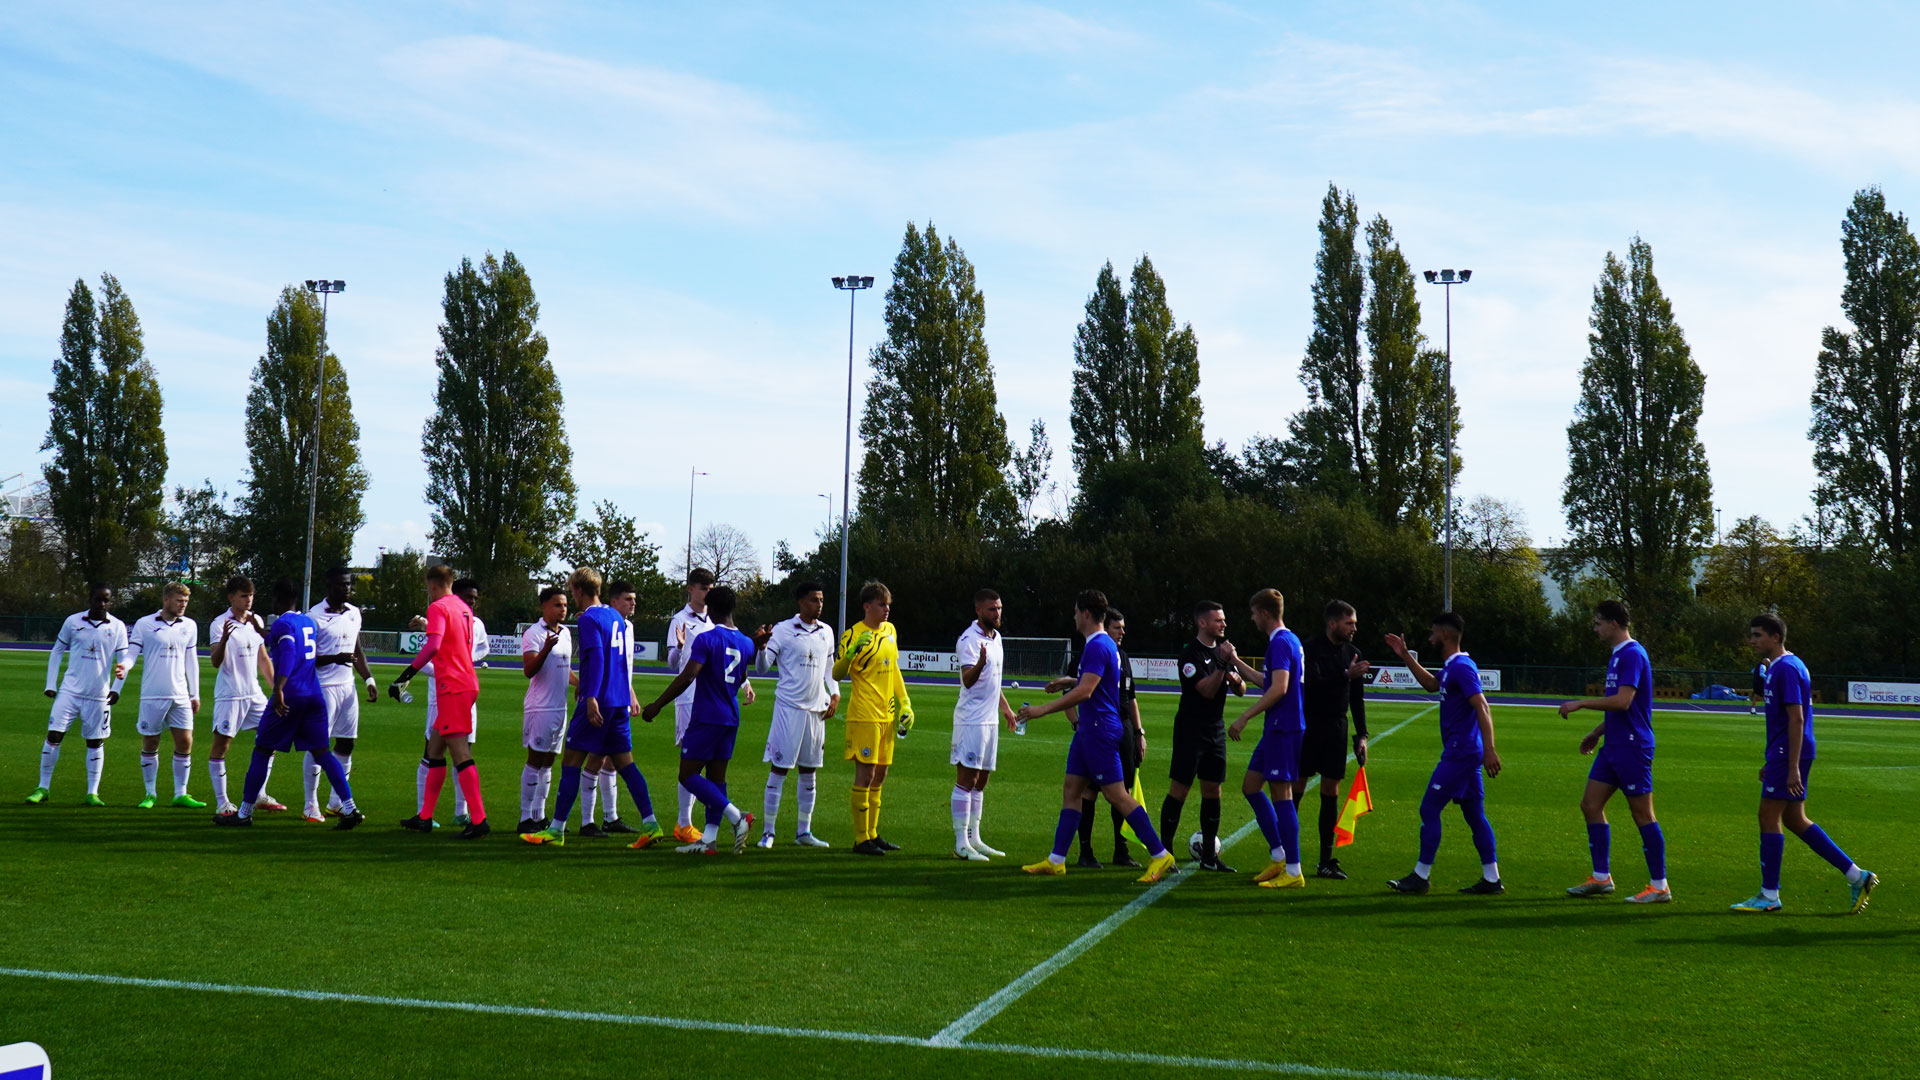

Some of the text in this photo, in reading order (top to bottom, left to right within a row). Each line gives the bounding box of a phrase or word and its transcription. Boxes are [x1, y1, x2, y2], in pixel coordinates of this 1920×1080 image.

[302, 626, 316, 660] 5
[611, 620, 624, 656] 4
[724, 647, 741, 684] 2
[908, 653, 939, 662] Capital
[1869, 694, 1899, 702] HOUSE
[1913, 695, 1920, 703] S
